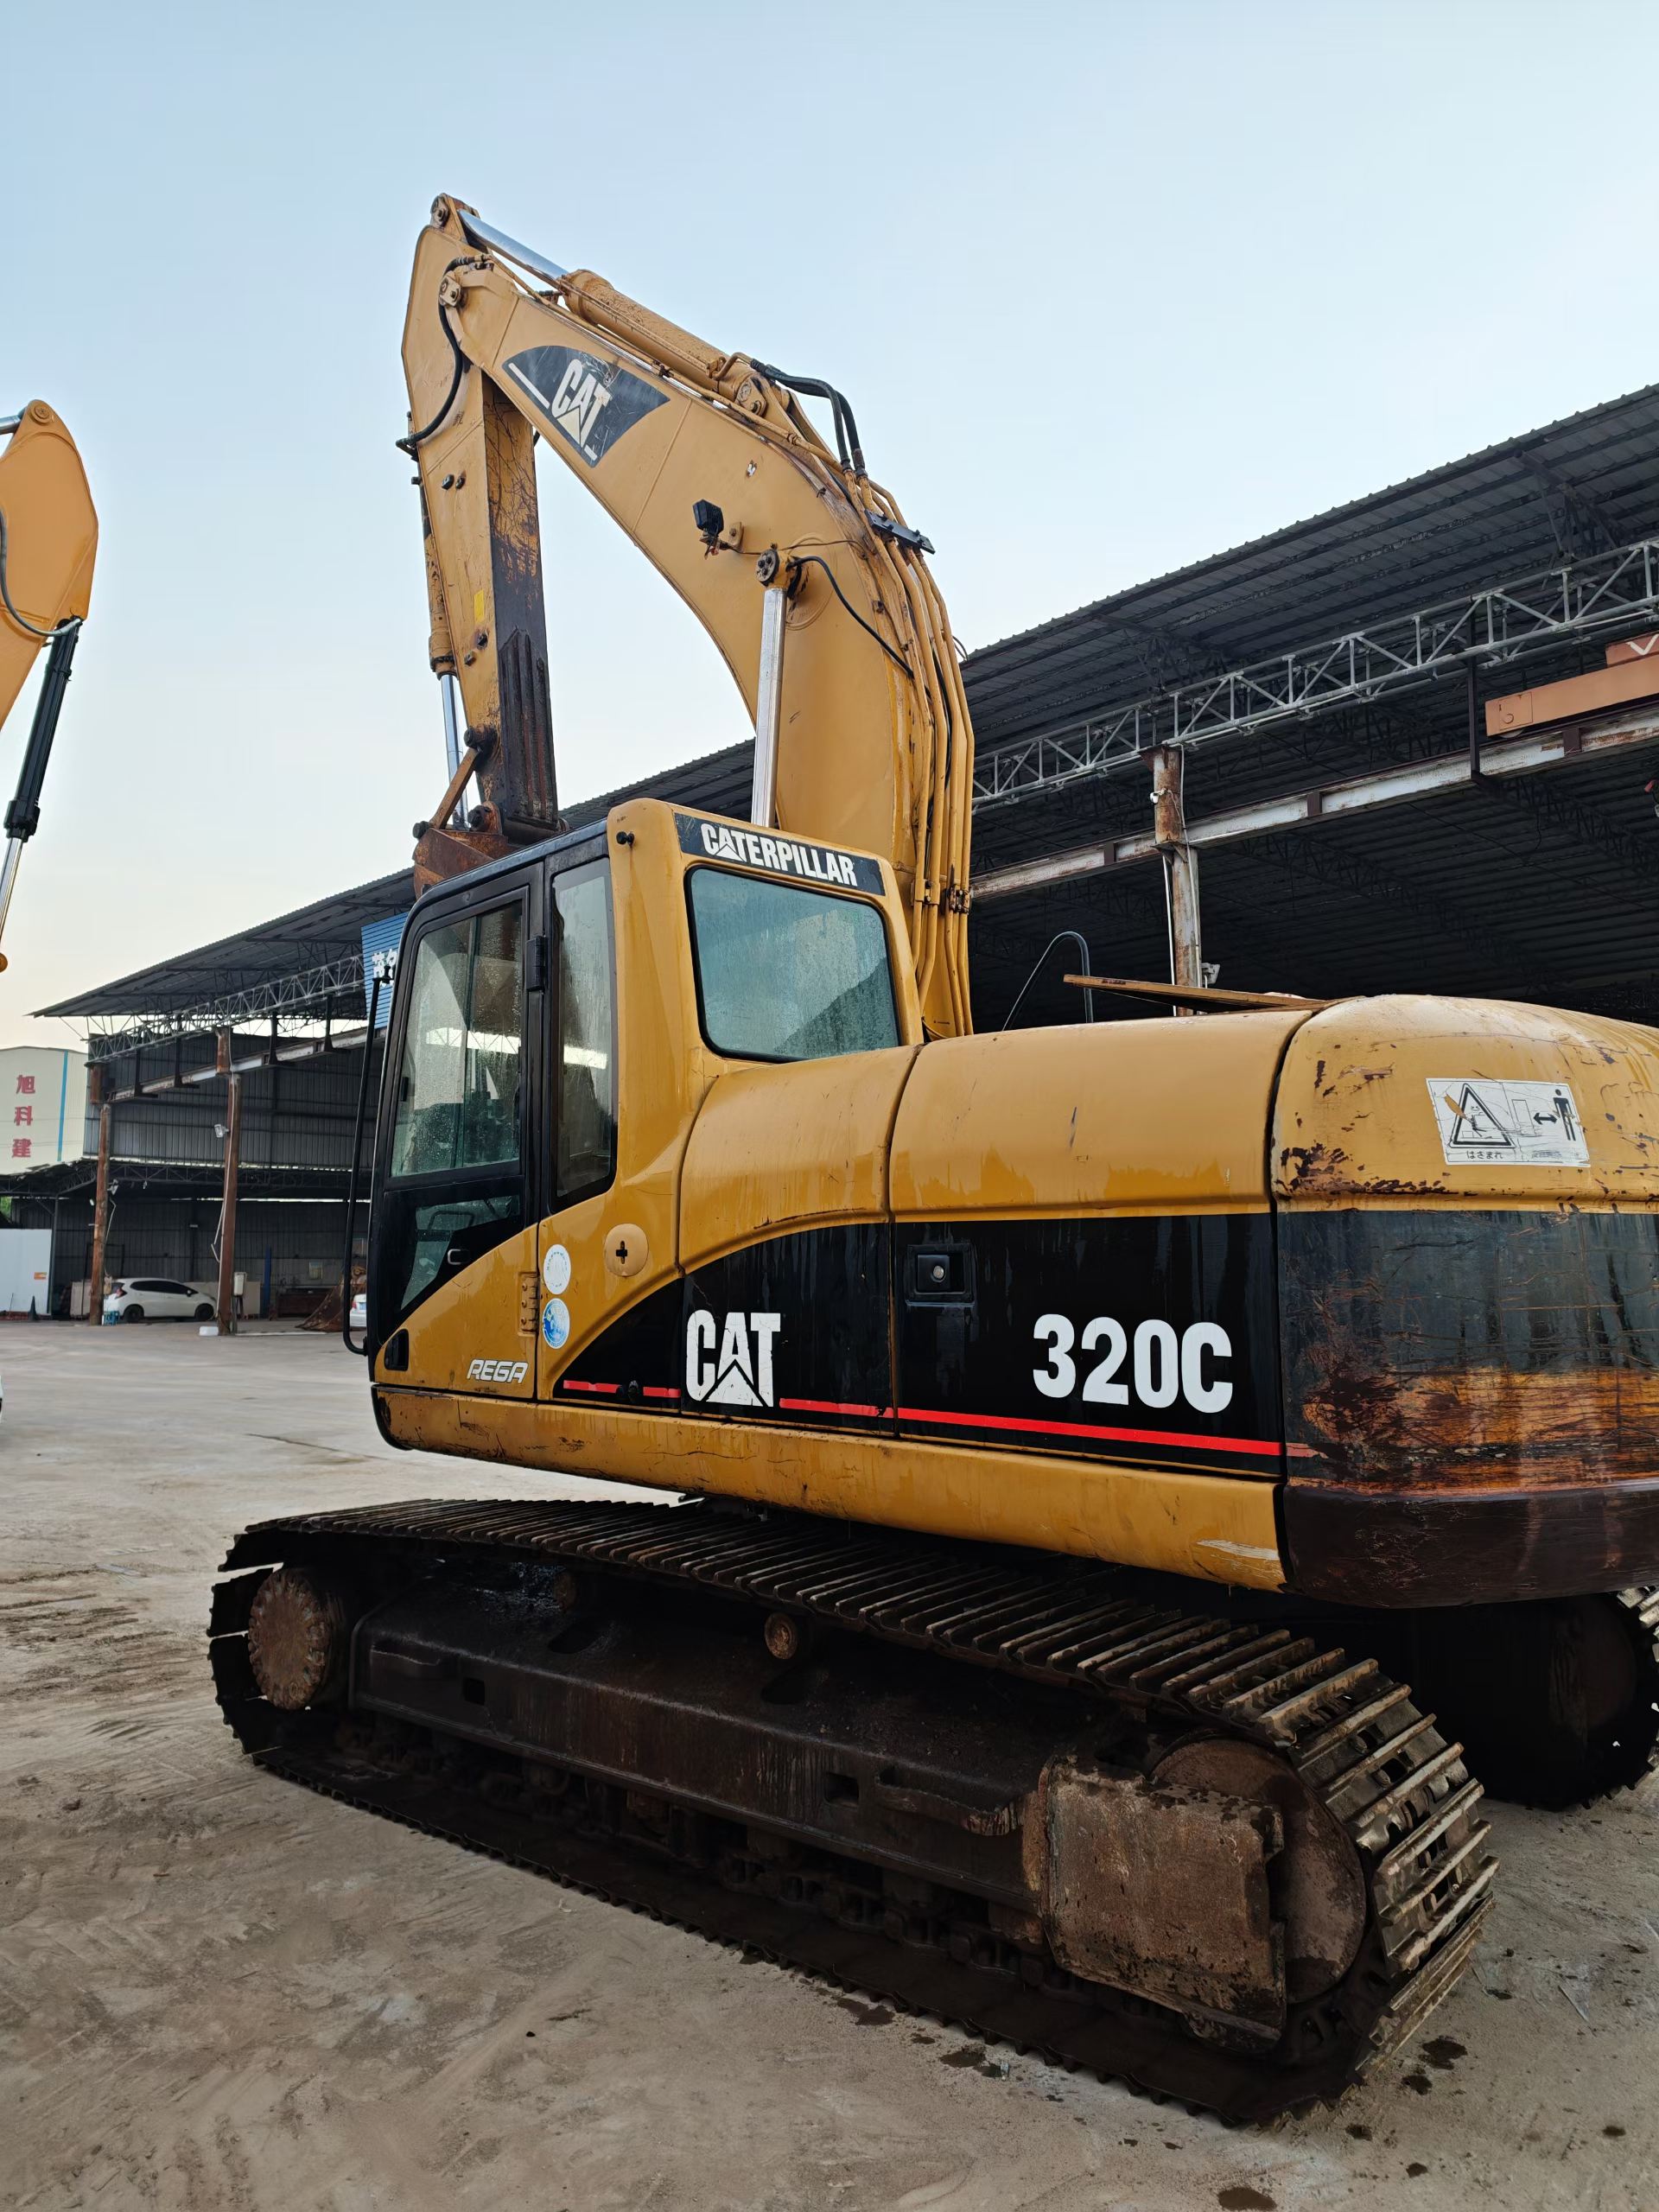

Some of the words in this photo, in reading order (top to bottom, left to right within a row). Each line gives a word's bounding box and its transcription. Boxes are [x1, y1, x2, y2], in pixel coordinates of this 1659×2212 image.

[551, 359, 613, 448] CAT
[701, 823, 858, 887] CATERPILLAR
[11, 1074, 36, 1159] 旭科建
[1465, 1150, 1503, 1160] はさまれ
[467, 1358, 529, 1383] REGA
[685, 1308, 782, 1408] CAT
[1033, 1313, 1233, 1414] 320C
